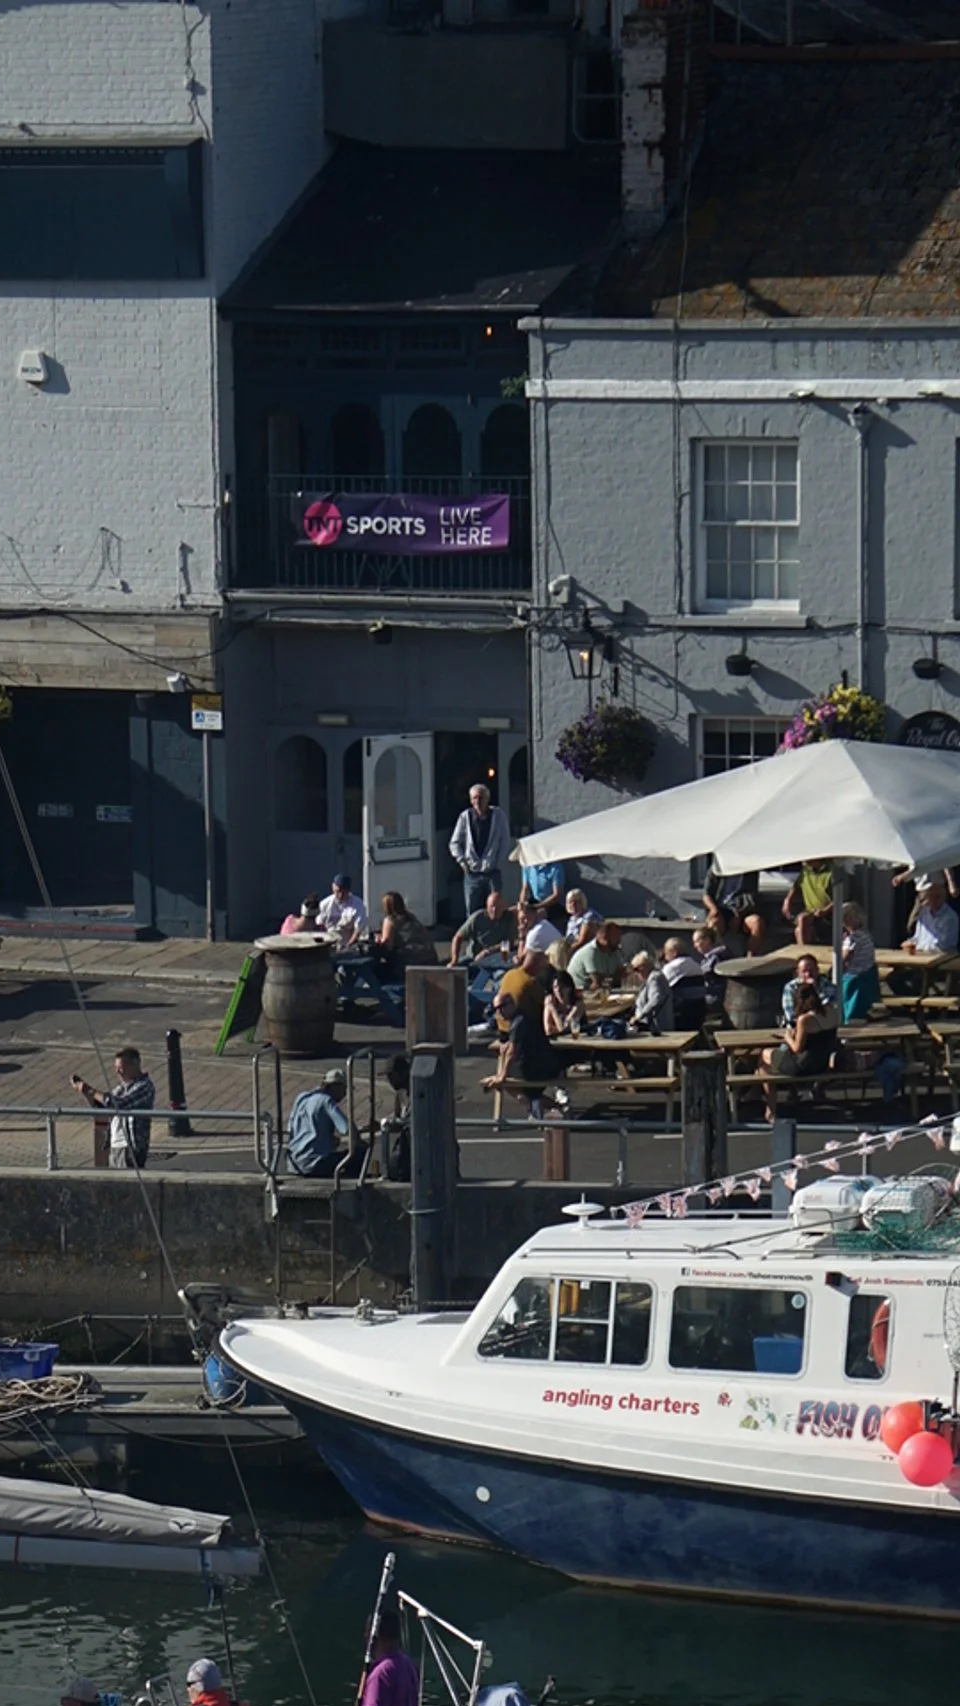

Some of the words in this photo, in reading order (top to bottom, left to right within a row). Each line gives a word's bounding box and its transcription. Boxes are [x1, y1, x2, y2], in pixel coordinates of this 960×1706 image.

[347, 516, 426, 535] SPORTS
[440, 507, 483, 525] LIVE
[440, 526, 492, 545] HERE
[542, 1388, 613, 1410] angling
[618, 1393, 701, 1416] charters
[796, 1400, 860, 1440] FISH
[862, 1404, 891, 1442] O
